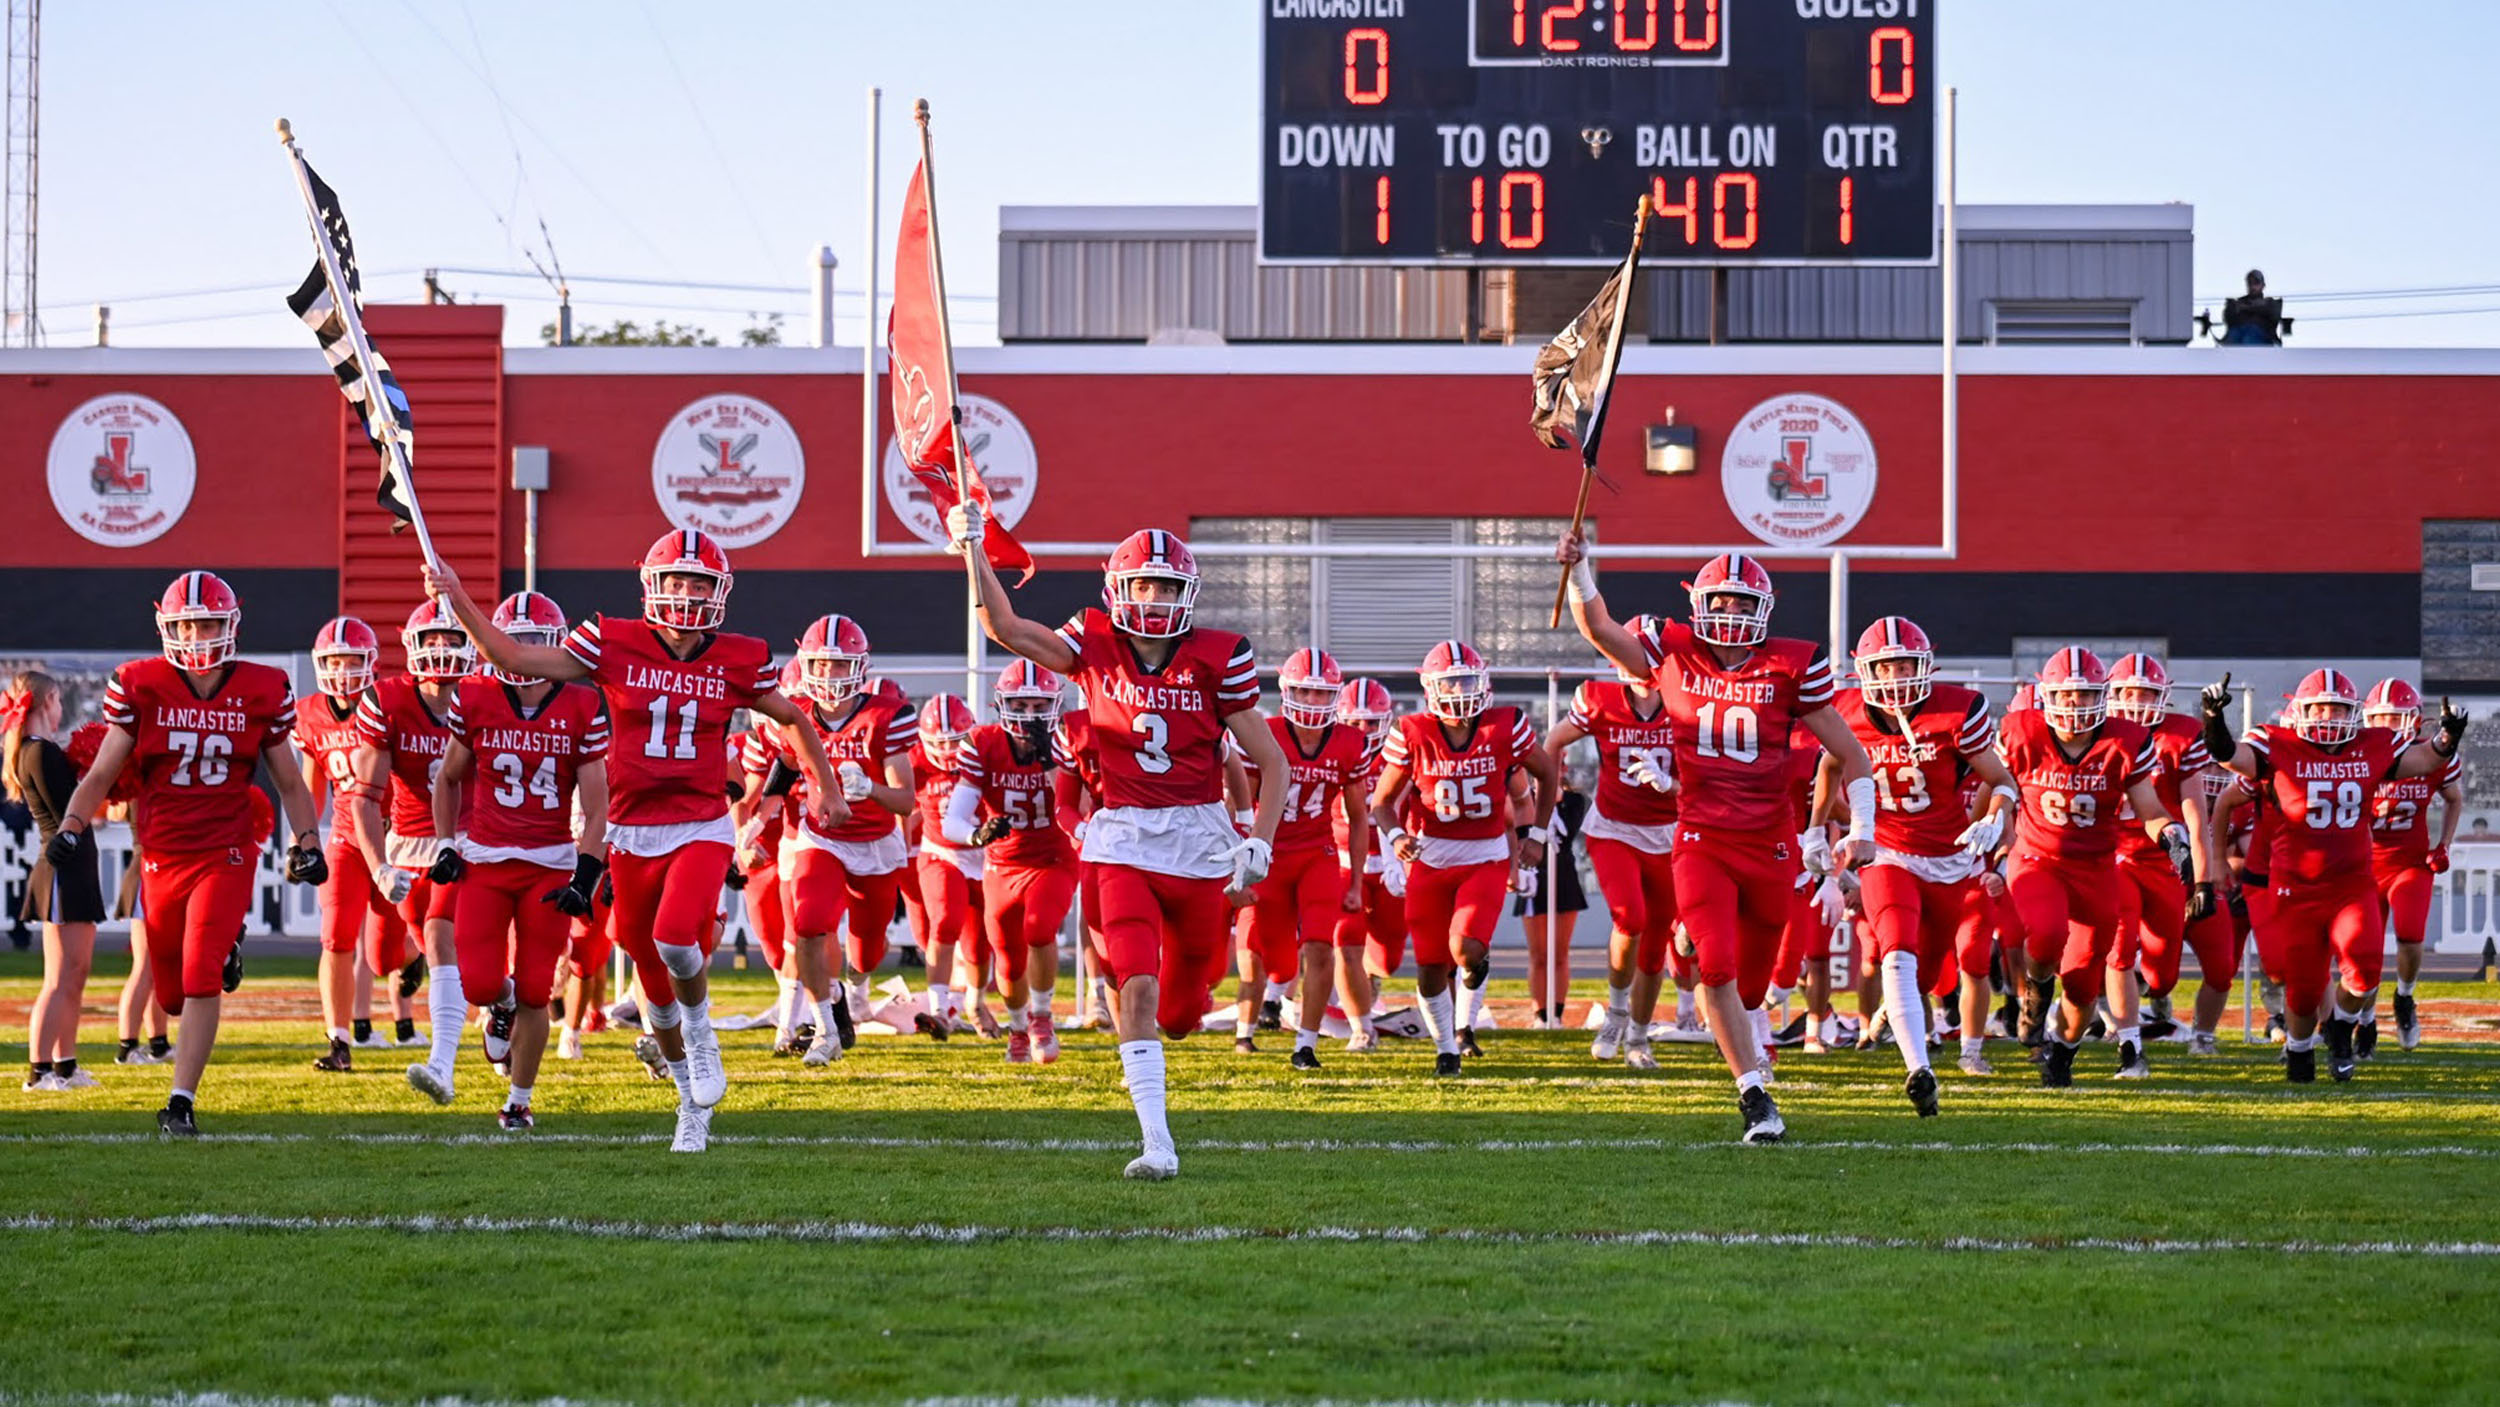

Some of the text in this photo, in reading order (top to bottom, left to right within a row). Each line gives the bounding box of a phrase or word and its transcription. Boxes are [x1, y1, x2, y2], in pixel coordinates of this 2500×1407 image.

[1345, 28, 1389, 104] 0
[1870, 27, 1914, 104] 0
[1279, 125, 1395, 167] DOWN
[1437, 125, 1551, 167] TO GO
[1636, 125, 1775, 167] BALL ON
[1822, 125, 1897, 170] QTR
[1377, 176, 1390, 244] 1
[1471, 172, 1543, 249] 10
[1653, 172, 1757, 249] 40
[1840, 176, 1852, 245] 1
[1780, 419, 1819, 432] 2020
[1771, 512, 1845, 537] CHAMPIONS
[626, 664, 726, 700] LANCASTER
[1102, 674, 1203, 711] LANCASTER
[1681, 671, 1775, 703] LANCASTER
[157, 707, 246, 732] LANCASTER
[644, 695, 697, 759] 11
[1609, 727, 1674, 745] LANCASTE
[1696, 702, 1759, 763] 10
[168, 731, 232, 786] 76
[482, 728, 571, 755] LANCASTER
[1132, 712, 1173, 774] 3
[492, 752, 560, 810] 34
[1423, 756, 1497, 777] LANCASTER
[2031, 768, 2107, 791] LANCASTER
[2296, 761, 2370, 778] LANCASTER
[1004, 790, 1050, 829] 51
[1434, 776, 1492, 822] 85
[1872, 766, 1931, 813] 13
[2040, 791, 2096, 828] 69
[2305, 781, 2362, 830] 58
[2372, 800, 2417, 830] 12
